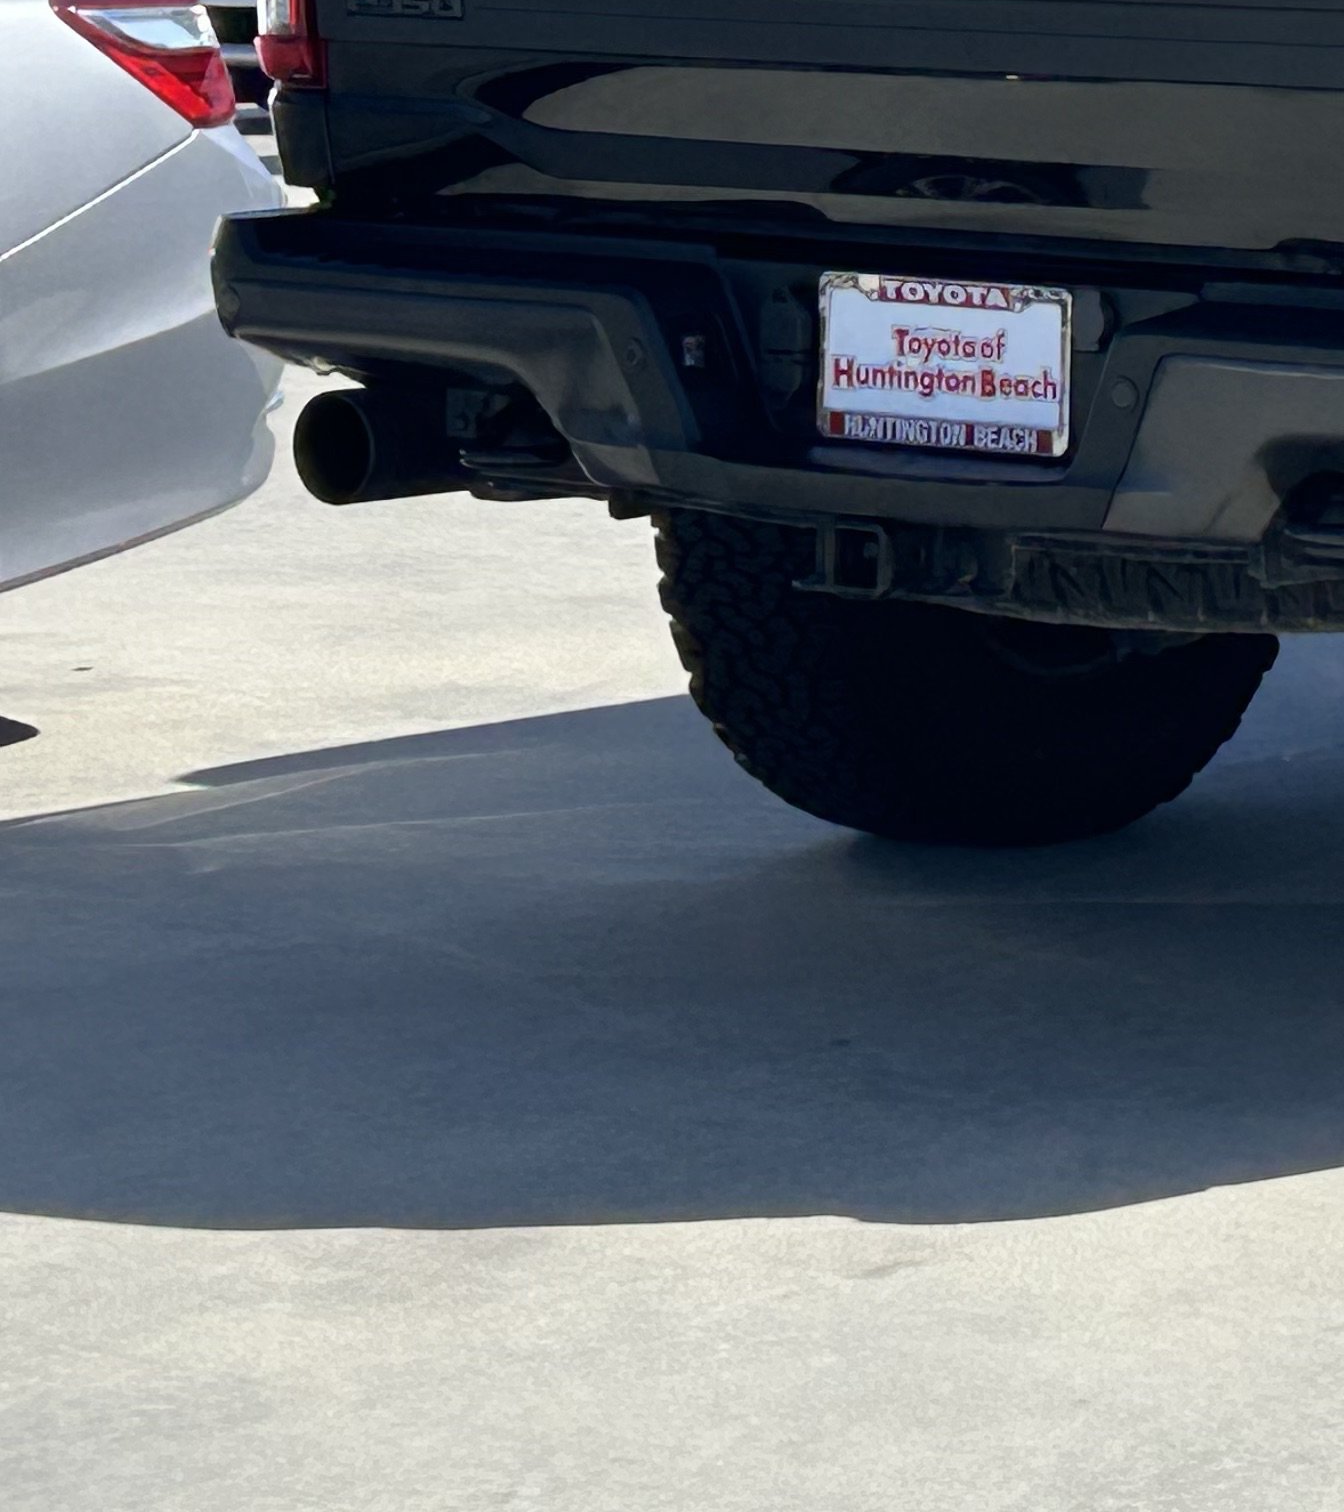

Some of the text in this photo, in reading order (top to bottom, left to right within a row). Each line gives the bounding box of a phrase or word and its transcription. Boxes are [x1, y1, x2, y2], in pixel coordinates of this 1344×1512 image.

[882, 282, 1009, 308] TOYOTA
[893, 328, 1006, 363] Toyota of
[832, 358, 1057, 400] Huntington Beach
[844, 414, 1037, 453] HUNTINGTON BEACH
